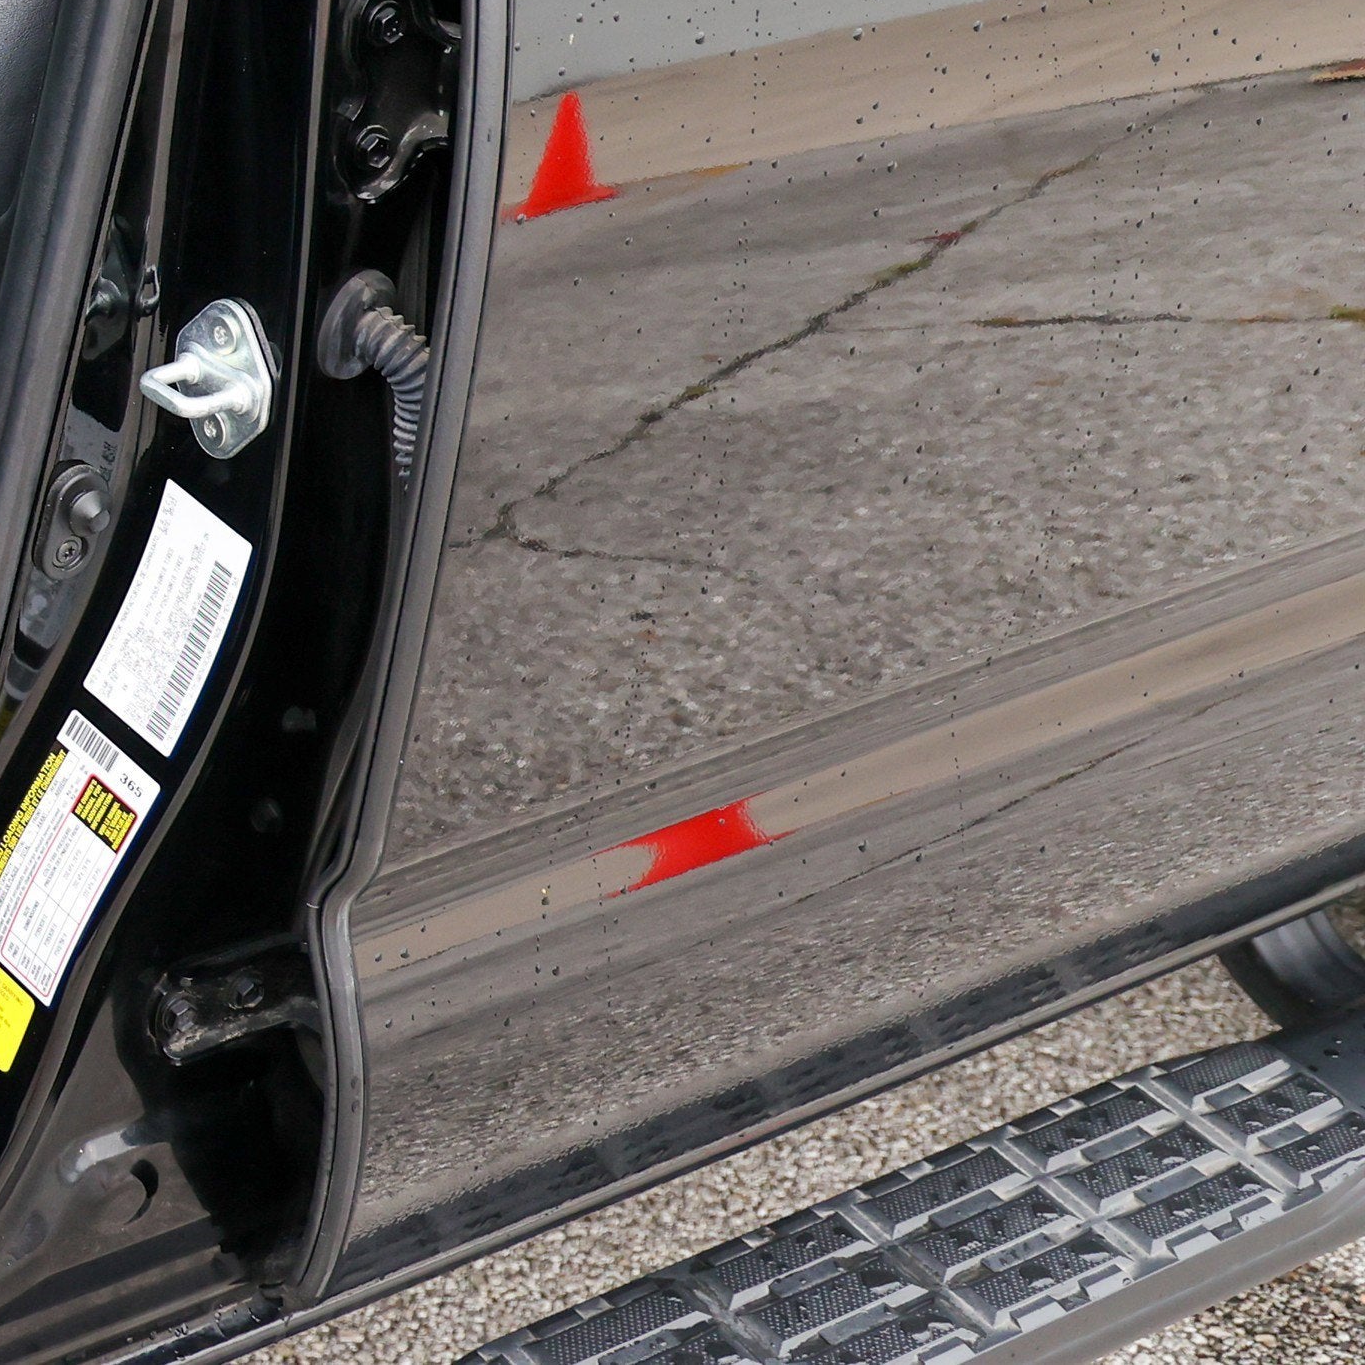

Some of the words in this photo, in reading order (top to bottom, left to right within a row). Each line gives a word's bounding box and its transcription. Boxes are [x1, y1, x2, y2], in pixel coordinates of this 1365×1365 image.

[0, 808, 24, 848] LOADING
[19, 751, 56, 811] INFORMATION
[119, 772, 143, 798] 365
[89, 791, 114, 831] INFORMATION
